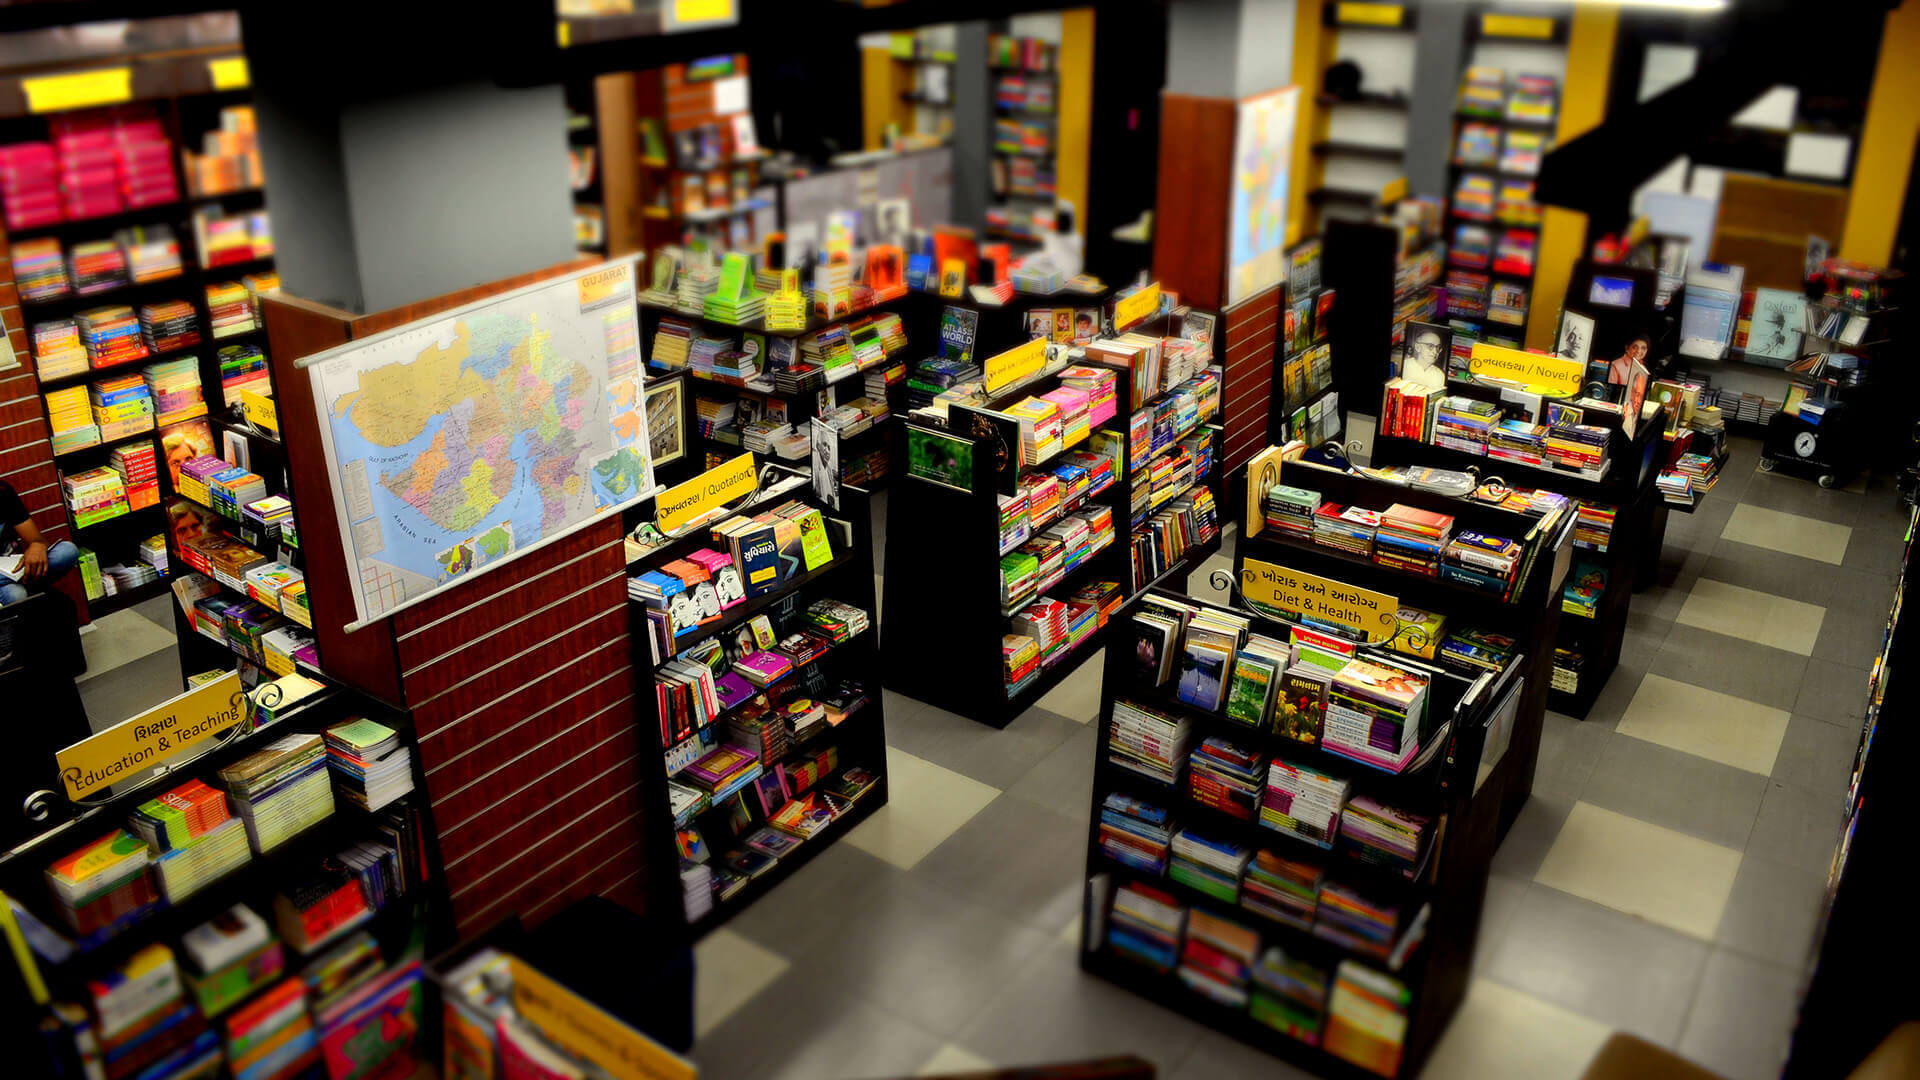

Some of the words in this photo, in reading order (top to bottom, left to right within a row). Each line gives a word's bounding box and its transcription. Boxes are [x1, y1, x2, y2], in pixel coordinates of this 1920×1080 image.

[582, 265, 628, 288] GUJARAT
[942, 331, 973, 345] WORLD
[943, 323, 968, 336] ATLAS
[1536, 366, 1569, 381] Novel
[394, 514, 417, 539] ARABIAN
[423, 537, 437, 545] SEA
[743, 540, 776, 563] સુવિચારો
[1262, 569, 1297, 589] ખોરાક
[1302, 582, 1326, 597] અને
[1331, 590, 1378, 611] આરોગ્ય
[1273, 589, 1301, 608] Diet
[1303, 598, 1314, 611] &
[1318, 602, 1363, 625] Health
[133, 715, 178, 742] શિક્ષણ
[73, 745, 155, 792] Education
[158, 736, 171, 752] &
[173, 706, 241, 744] Teaching
